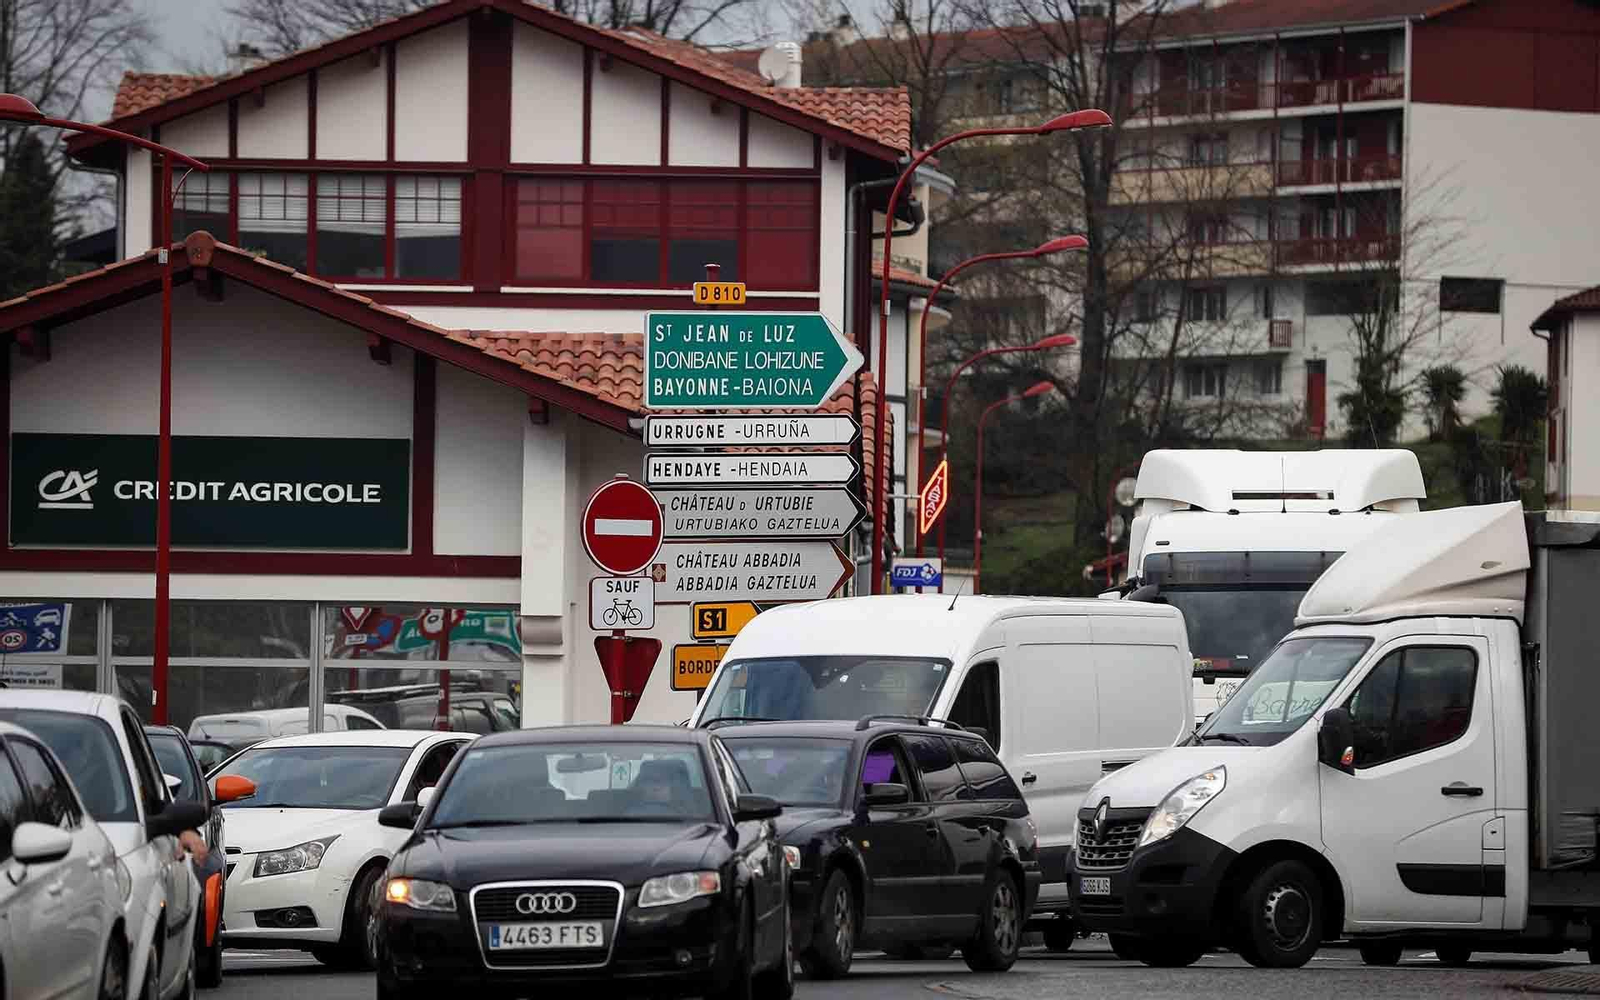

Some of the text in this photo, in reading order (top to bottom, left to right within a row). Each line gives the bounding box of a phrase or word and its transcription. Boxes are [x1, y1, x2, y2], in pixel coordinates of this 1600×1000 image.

[700, 286, 741, 300] D 810
[683, 325, 729, 342] JEAN
[764, 325, 795, 342] LUZ
[654, 351, 824, 369] DONIBANE LOHIZUNE
[653, 424, 725, 439] URRUGNE
[653, 462, 721, 477] HENDAYE
[228, 482, 381, 503] AGRICOLE
[925, 477, 943, 518] TABAC
[671, 493, 734, 511] CHÂTEAU
[755, 496, 814, 511] URTUBIE
[675, 518, 840, 530] URTUBIAKO GAZTELUA
[676, 551, 801, 568] CHÂTEAU ABBADIA
[896, 567, 917, 578] FDJ
[606, 580, 640, 593] SAUF
[676, 575, 816, 591] ABBADIA GAZTELUA
[702, 611, 724, 629] S1
[503, 926, 597, 945] 4463 FTS
